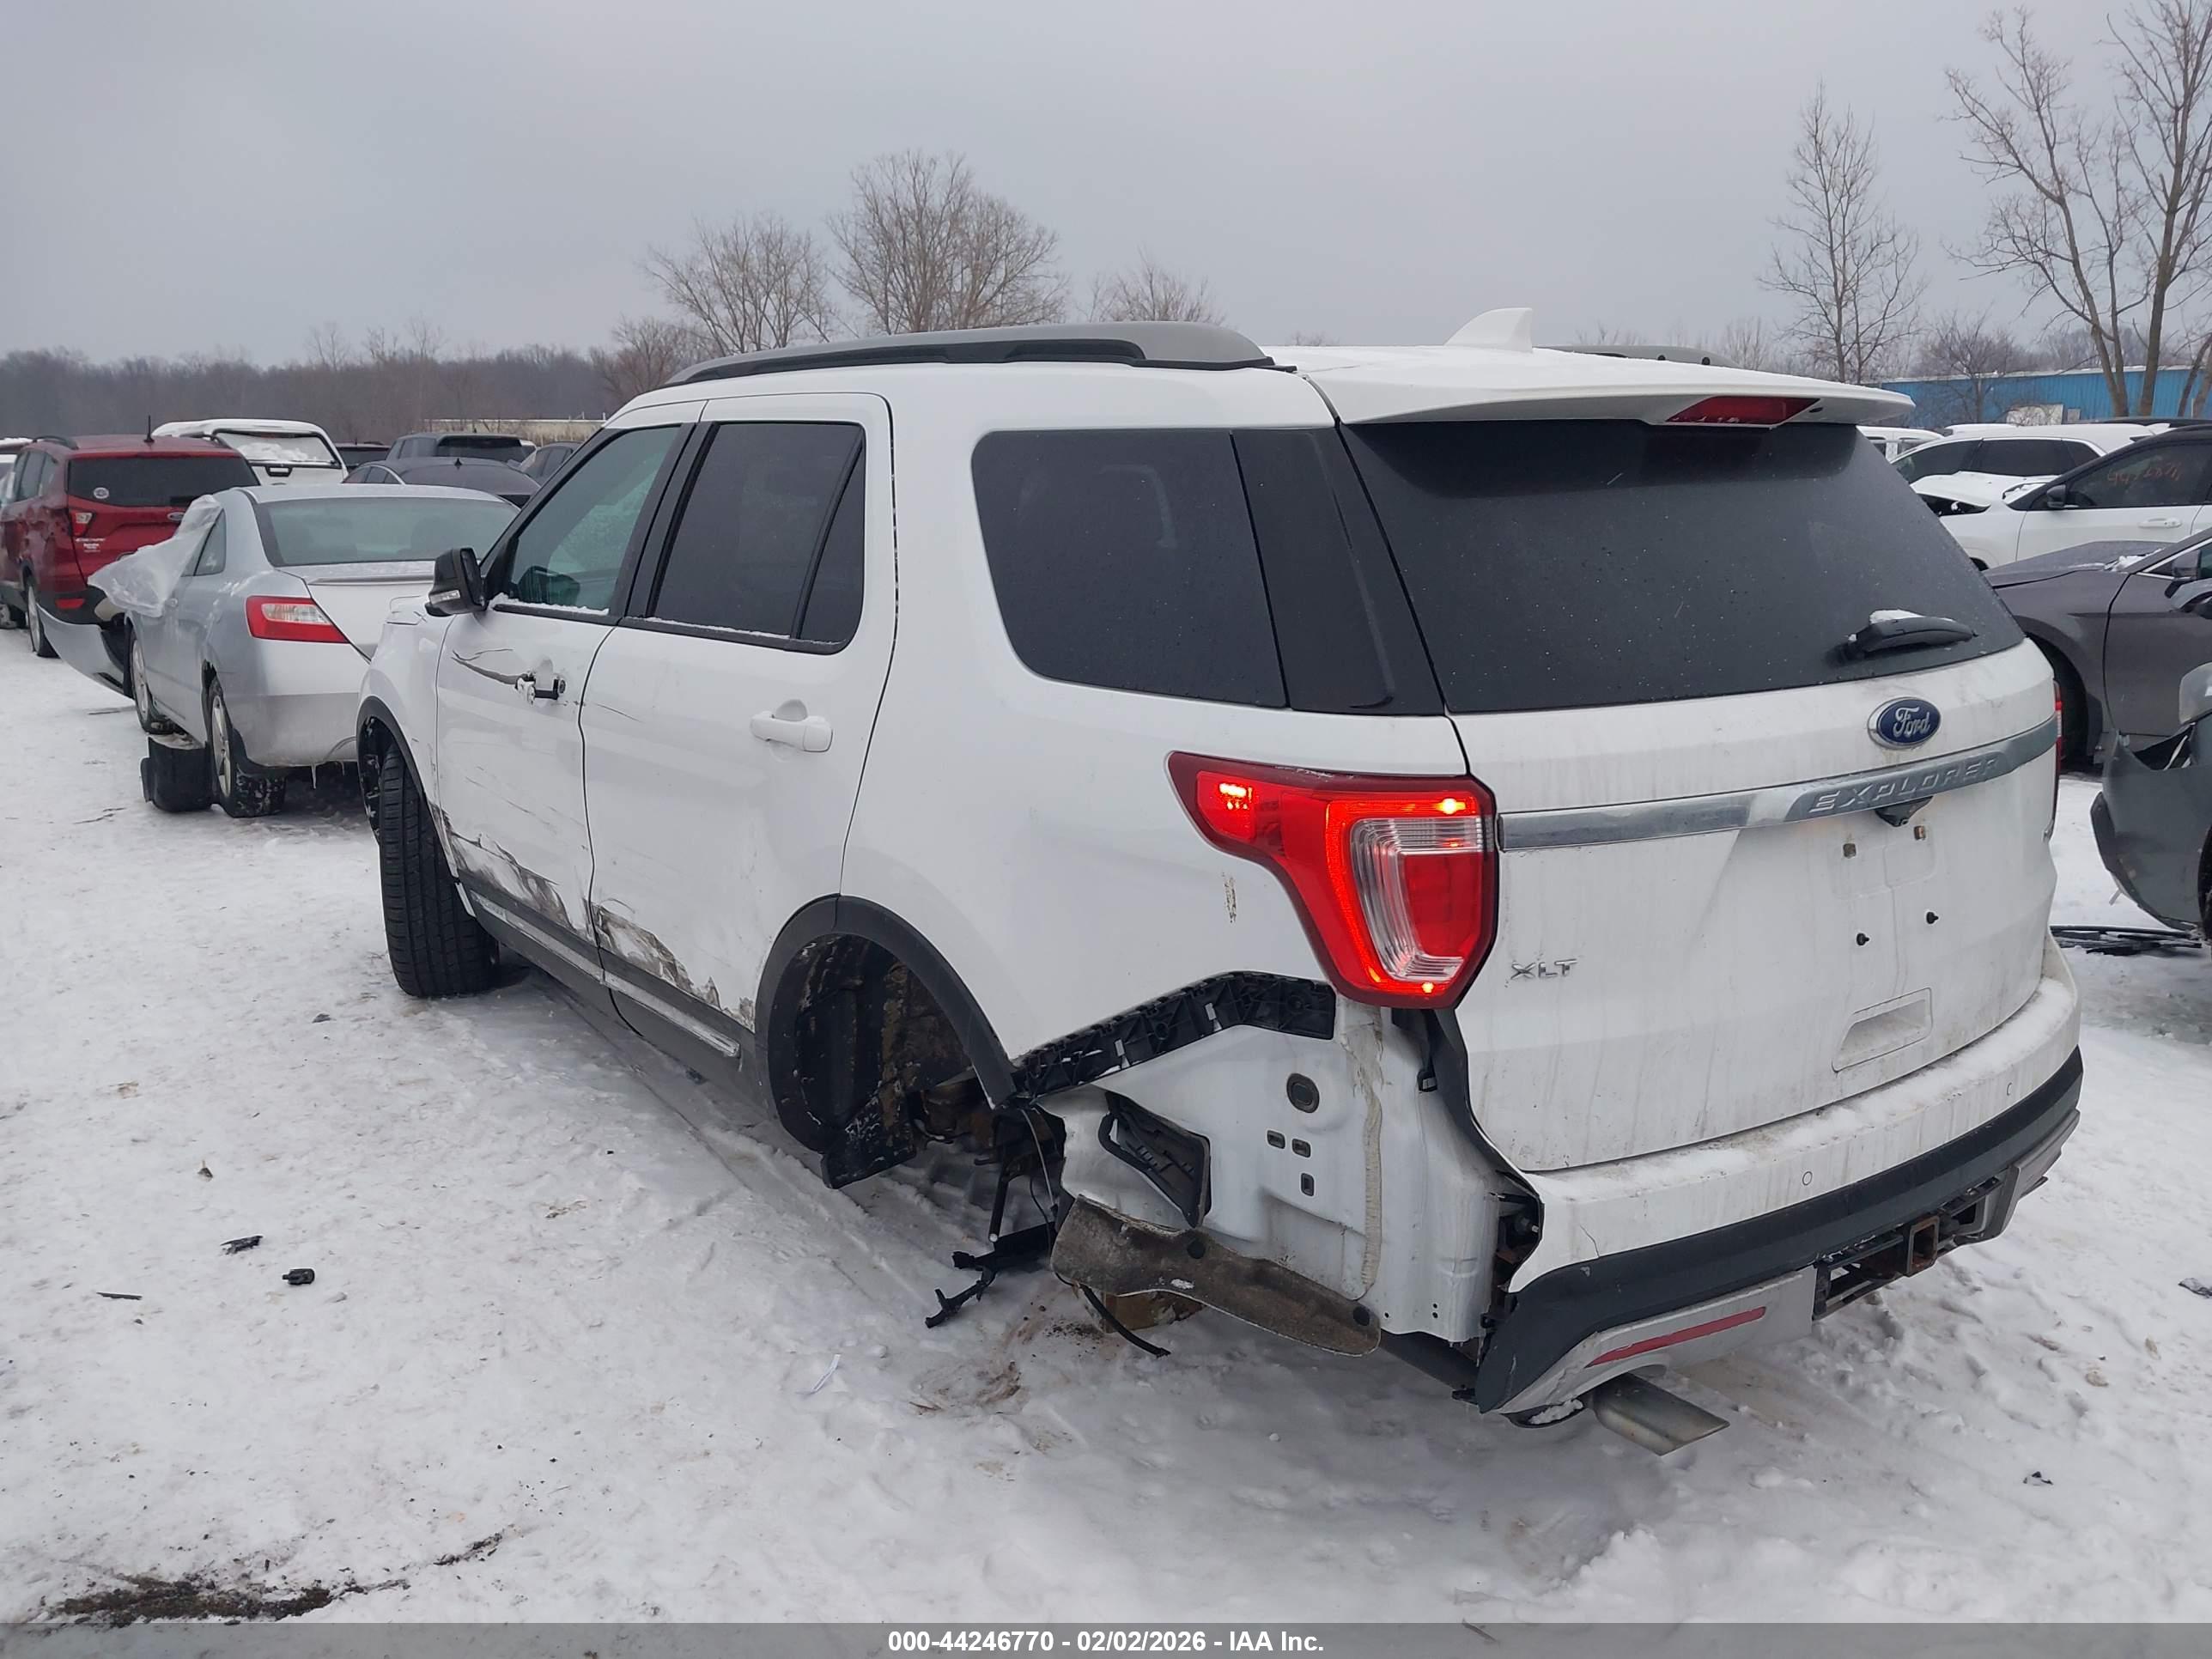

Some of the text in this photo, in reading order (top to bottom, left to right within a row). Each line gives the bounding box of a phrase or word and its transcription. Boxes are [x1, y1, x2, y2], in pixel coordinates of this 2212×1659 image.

[1893, 706, 1931, 738] Ford
[1808, 757, 2001, 813] EXPLORER
[1510, 957, 1577, 980] XLT
